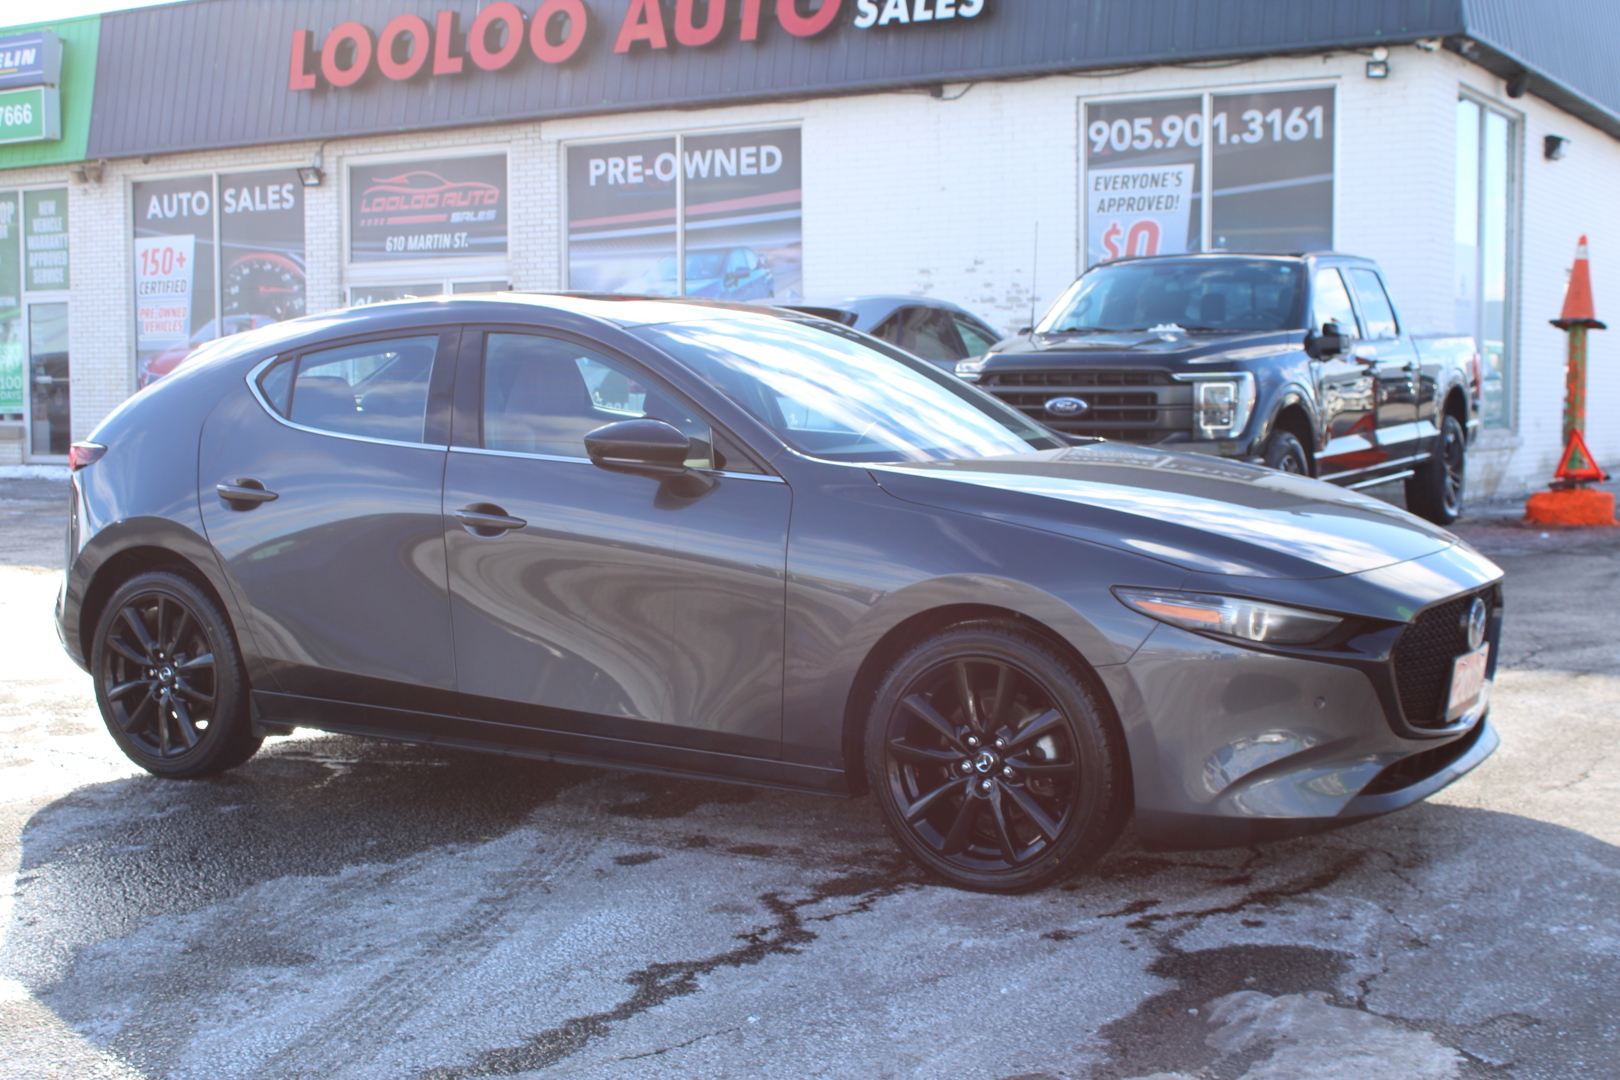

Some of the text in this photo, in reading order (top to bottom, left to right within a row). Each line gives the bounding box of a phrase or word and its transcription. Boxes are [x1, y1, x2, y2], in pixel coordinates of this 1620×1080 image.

[289, 0, 587, 91] LOOLOO
[613, 0, 843, 53] AUTO
[1088, 105, 1325, 153] 905.901.3161
[589, 145, 783, 186] PRE-OWNED
[1094, 171, 1184, 192] EVERYONE'S
[146, 183, 295, 219] AUTO SALES
[360, 190, 499, 213] LOOLOO AUTO
[1096, 195, 1180, 214] APPROVED!
[450, 210, 496, 223] SALES
[386, 232, 469, 252] 610 MARTIN ST.
[1101, 220, 1160, 263] $0
[141, 247, 187, 276] 150+
[33, 267, 64, 284] SERVICE
[139, 280, 187, 295] CERTIFIED
[139, 306, 188, 319] PRE-OWNED
[145, 320, 183, 333] VEHICLES
